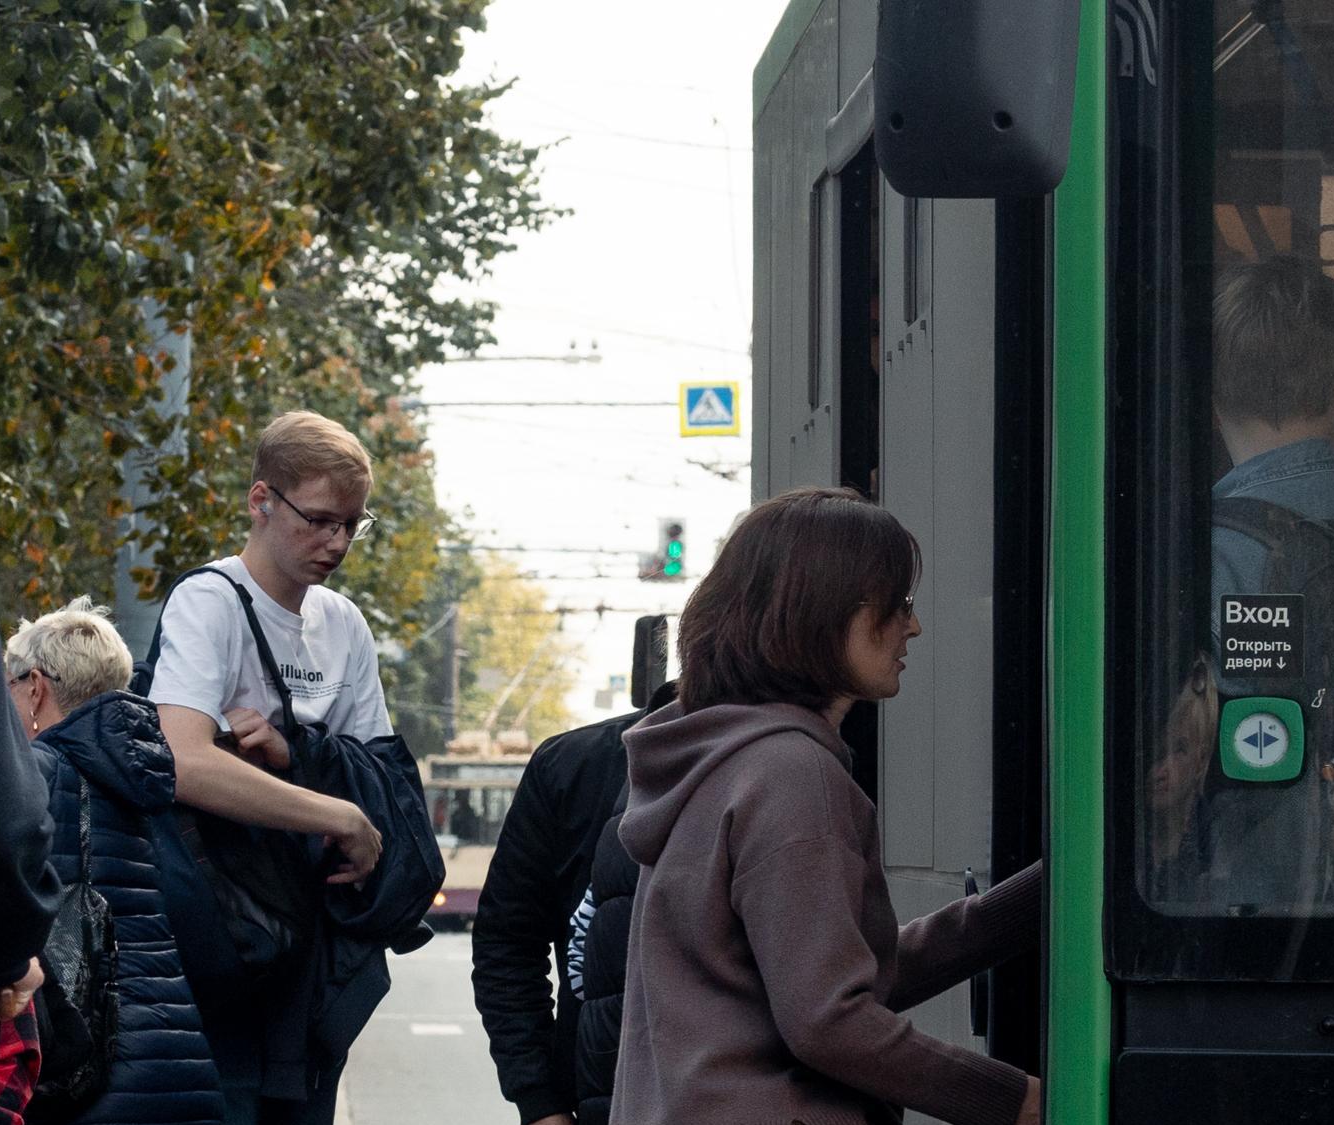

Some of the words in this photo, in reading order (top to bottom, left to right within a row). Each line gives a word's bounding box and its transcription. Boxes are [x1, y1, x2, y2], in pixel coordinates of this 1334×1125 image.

[1226, 601, 1290, 627] Вход
[1226, 637, 1292, 654] Открыть
[280, 663, 324, 682] illuion
[1225, 658, 1272, 671] двери
